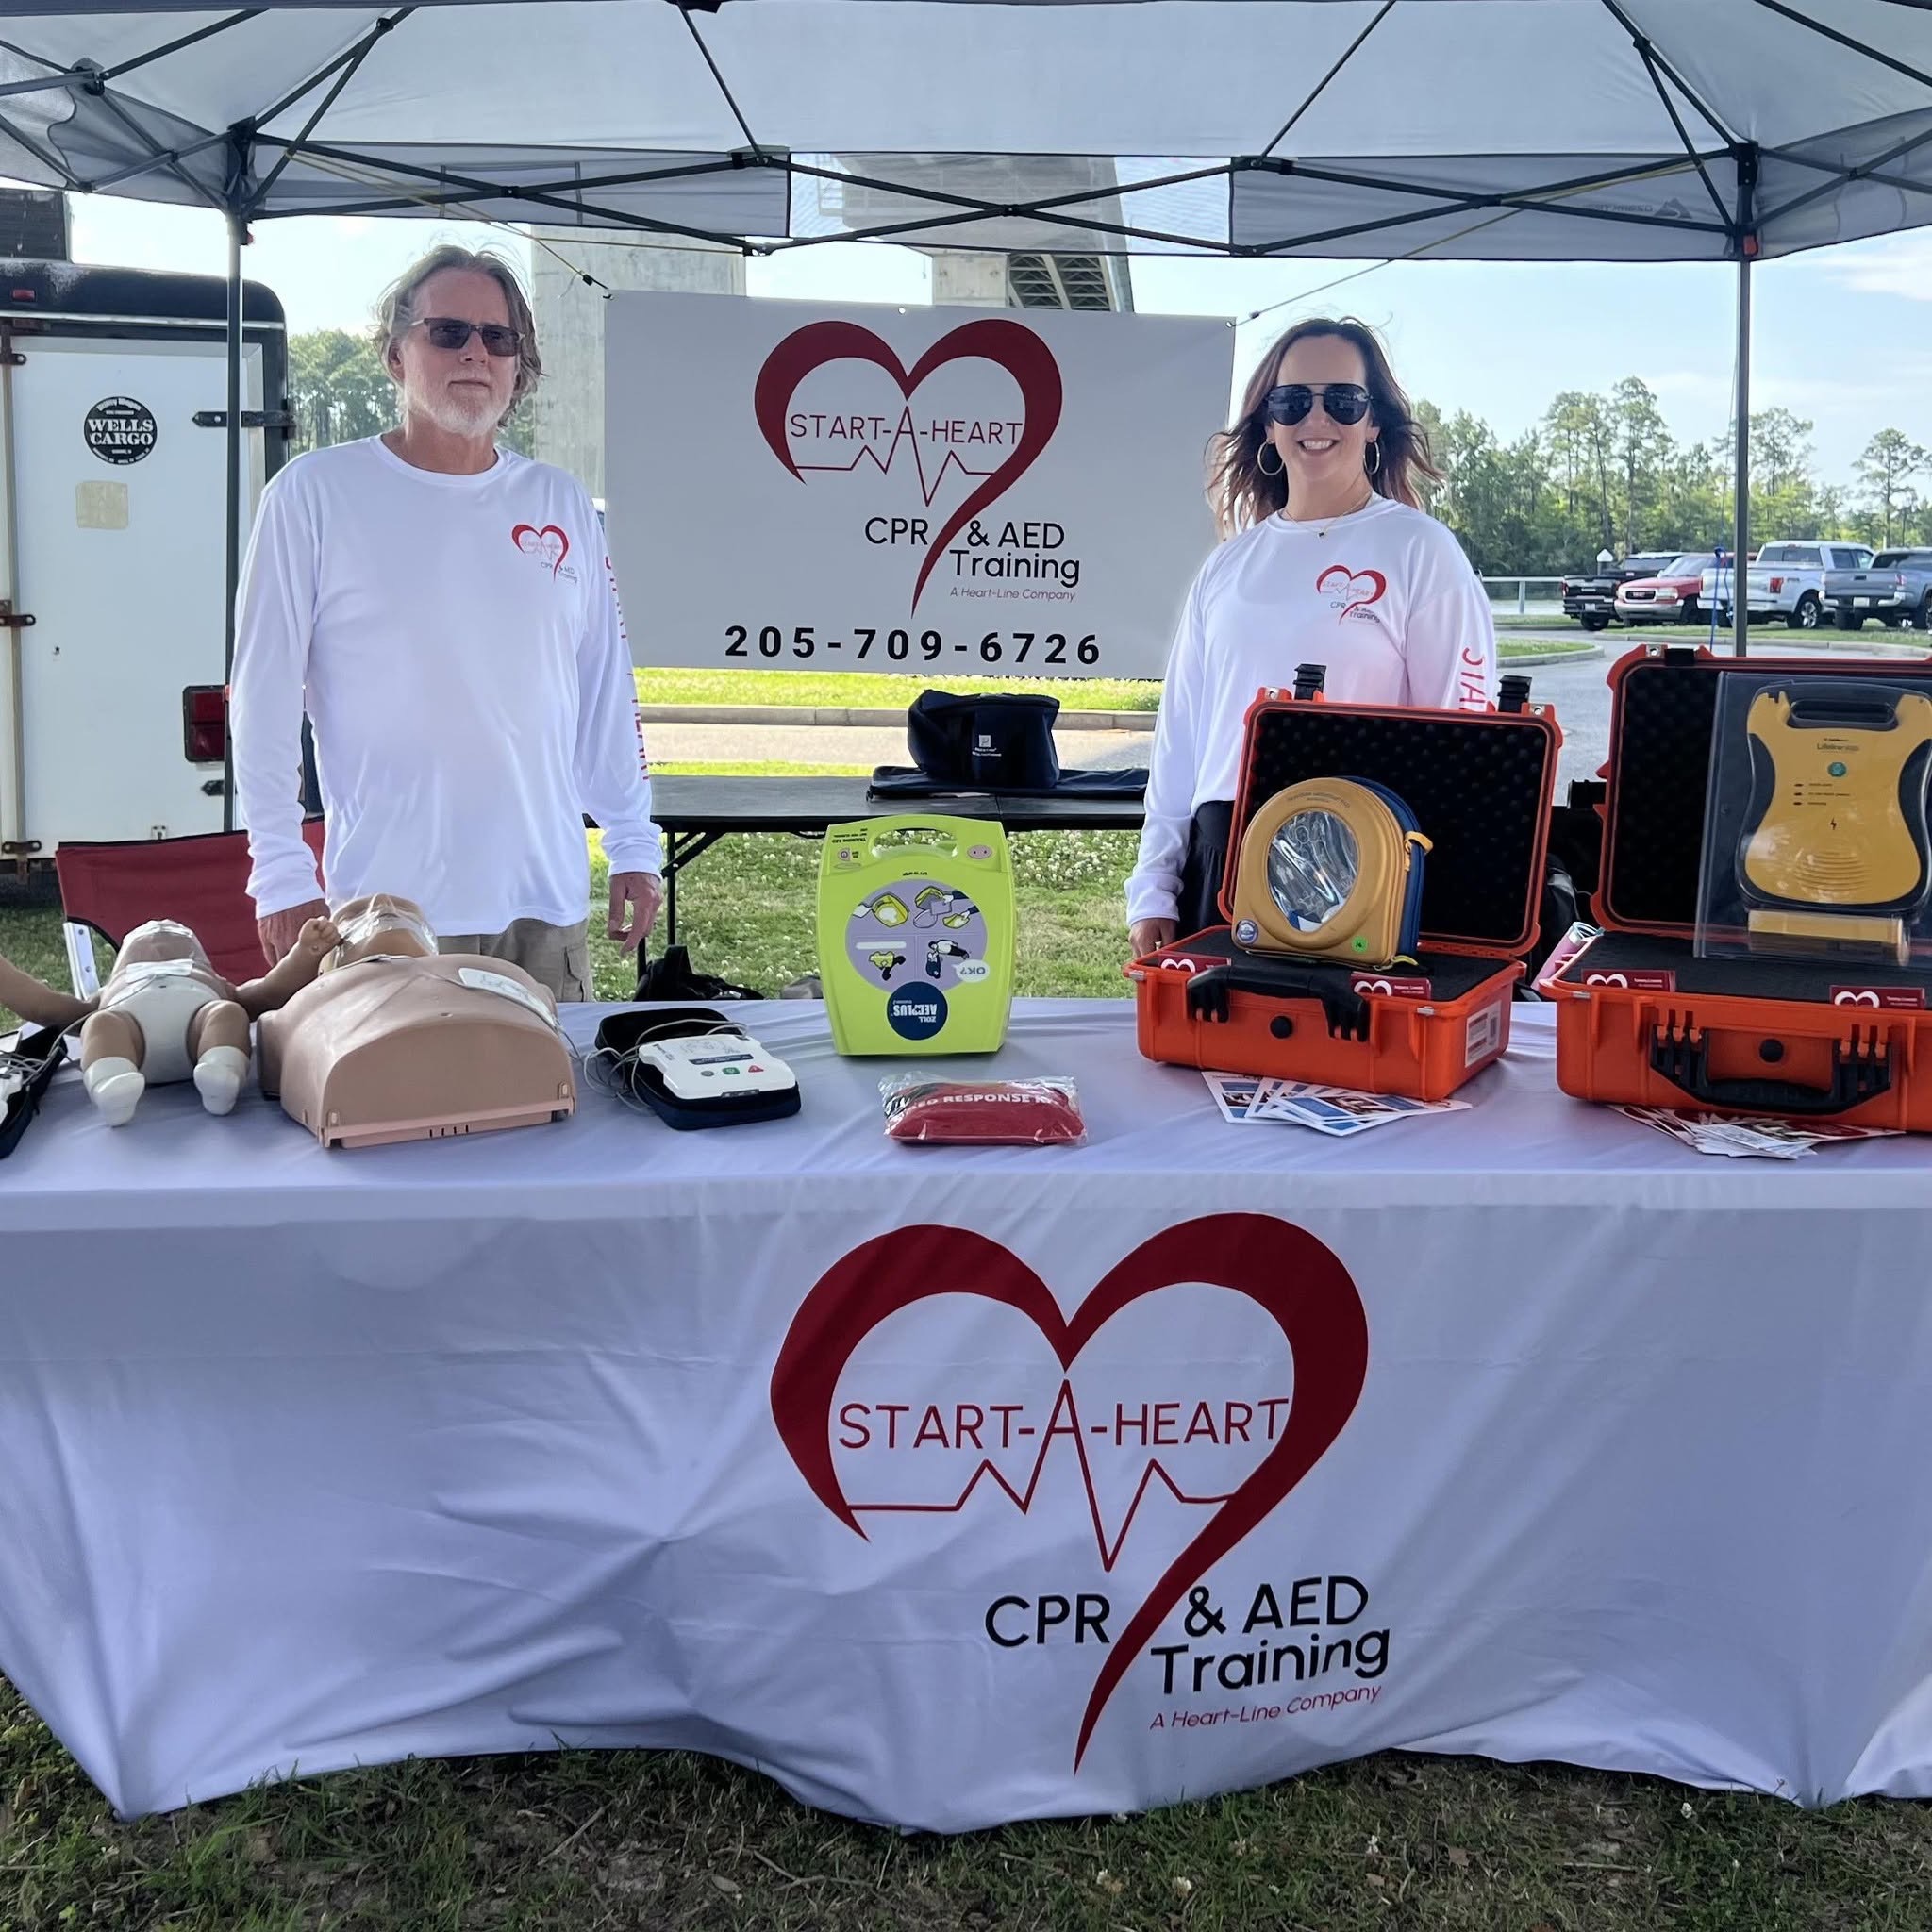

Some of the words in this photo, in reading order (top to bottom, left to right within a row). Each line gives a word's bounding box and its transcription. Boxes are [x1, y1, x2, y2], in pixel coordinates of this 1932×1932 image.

[88, 418, 154, 432] WELLS
[90, 432, 154, 445] CARGO
[789, 407, 1024, 445] START-A-HEART
[864, 516, 929, 546] CPR
[966, 519, 990, 547] &
[997, 521, 1065, 549] AED
[949, 549, 1080, 589] Training
[950, 586, 958, 597] A
[960, 587, 1020, 599] Heart-Line
[1022, 588, 1075, 603] Company
[724, 625, 1101, 665] 205-709-6726
[959, 966, 986, 975] OK?
[943, 1093, 1031, 1103] RESPONSE
[838, 1380, 1291, 1450] START-A-HEART
[984, 1592, 1111, 1647] CPR
[1183, 1585, 1227, 1636] &
[1241, 1574, 1370, 1635] AED
[1150, 1627, 1391, 1695] Training
[1149, 1711, 1165, 1730] A
[1171, 1702, 1281, 1729] Heart-Line
[1286, 1683, 1383, 1716] Company
